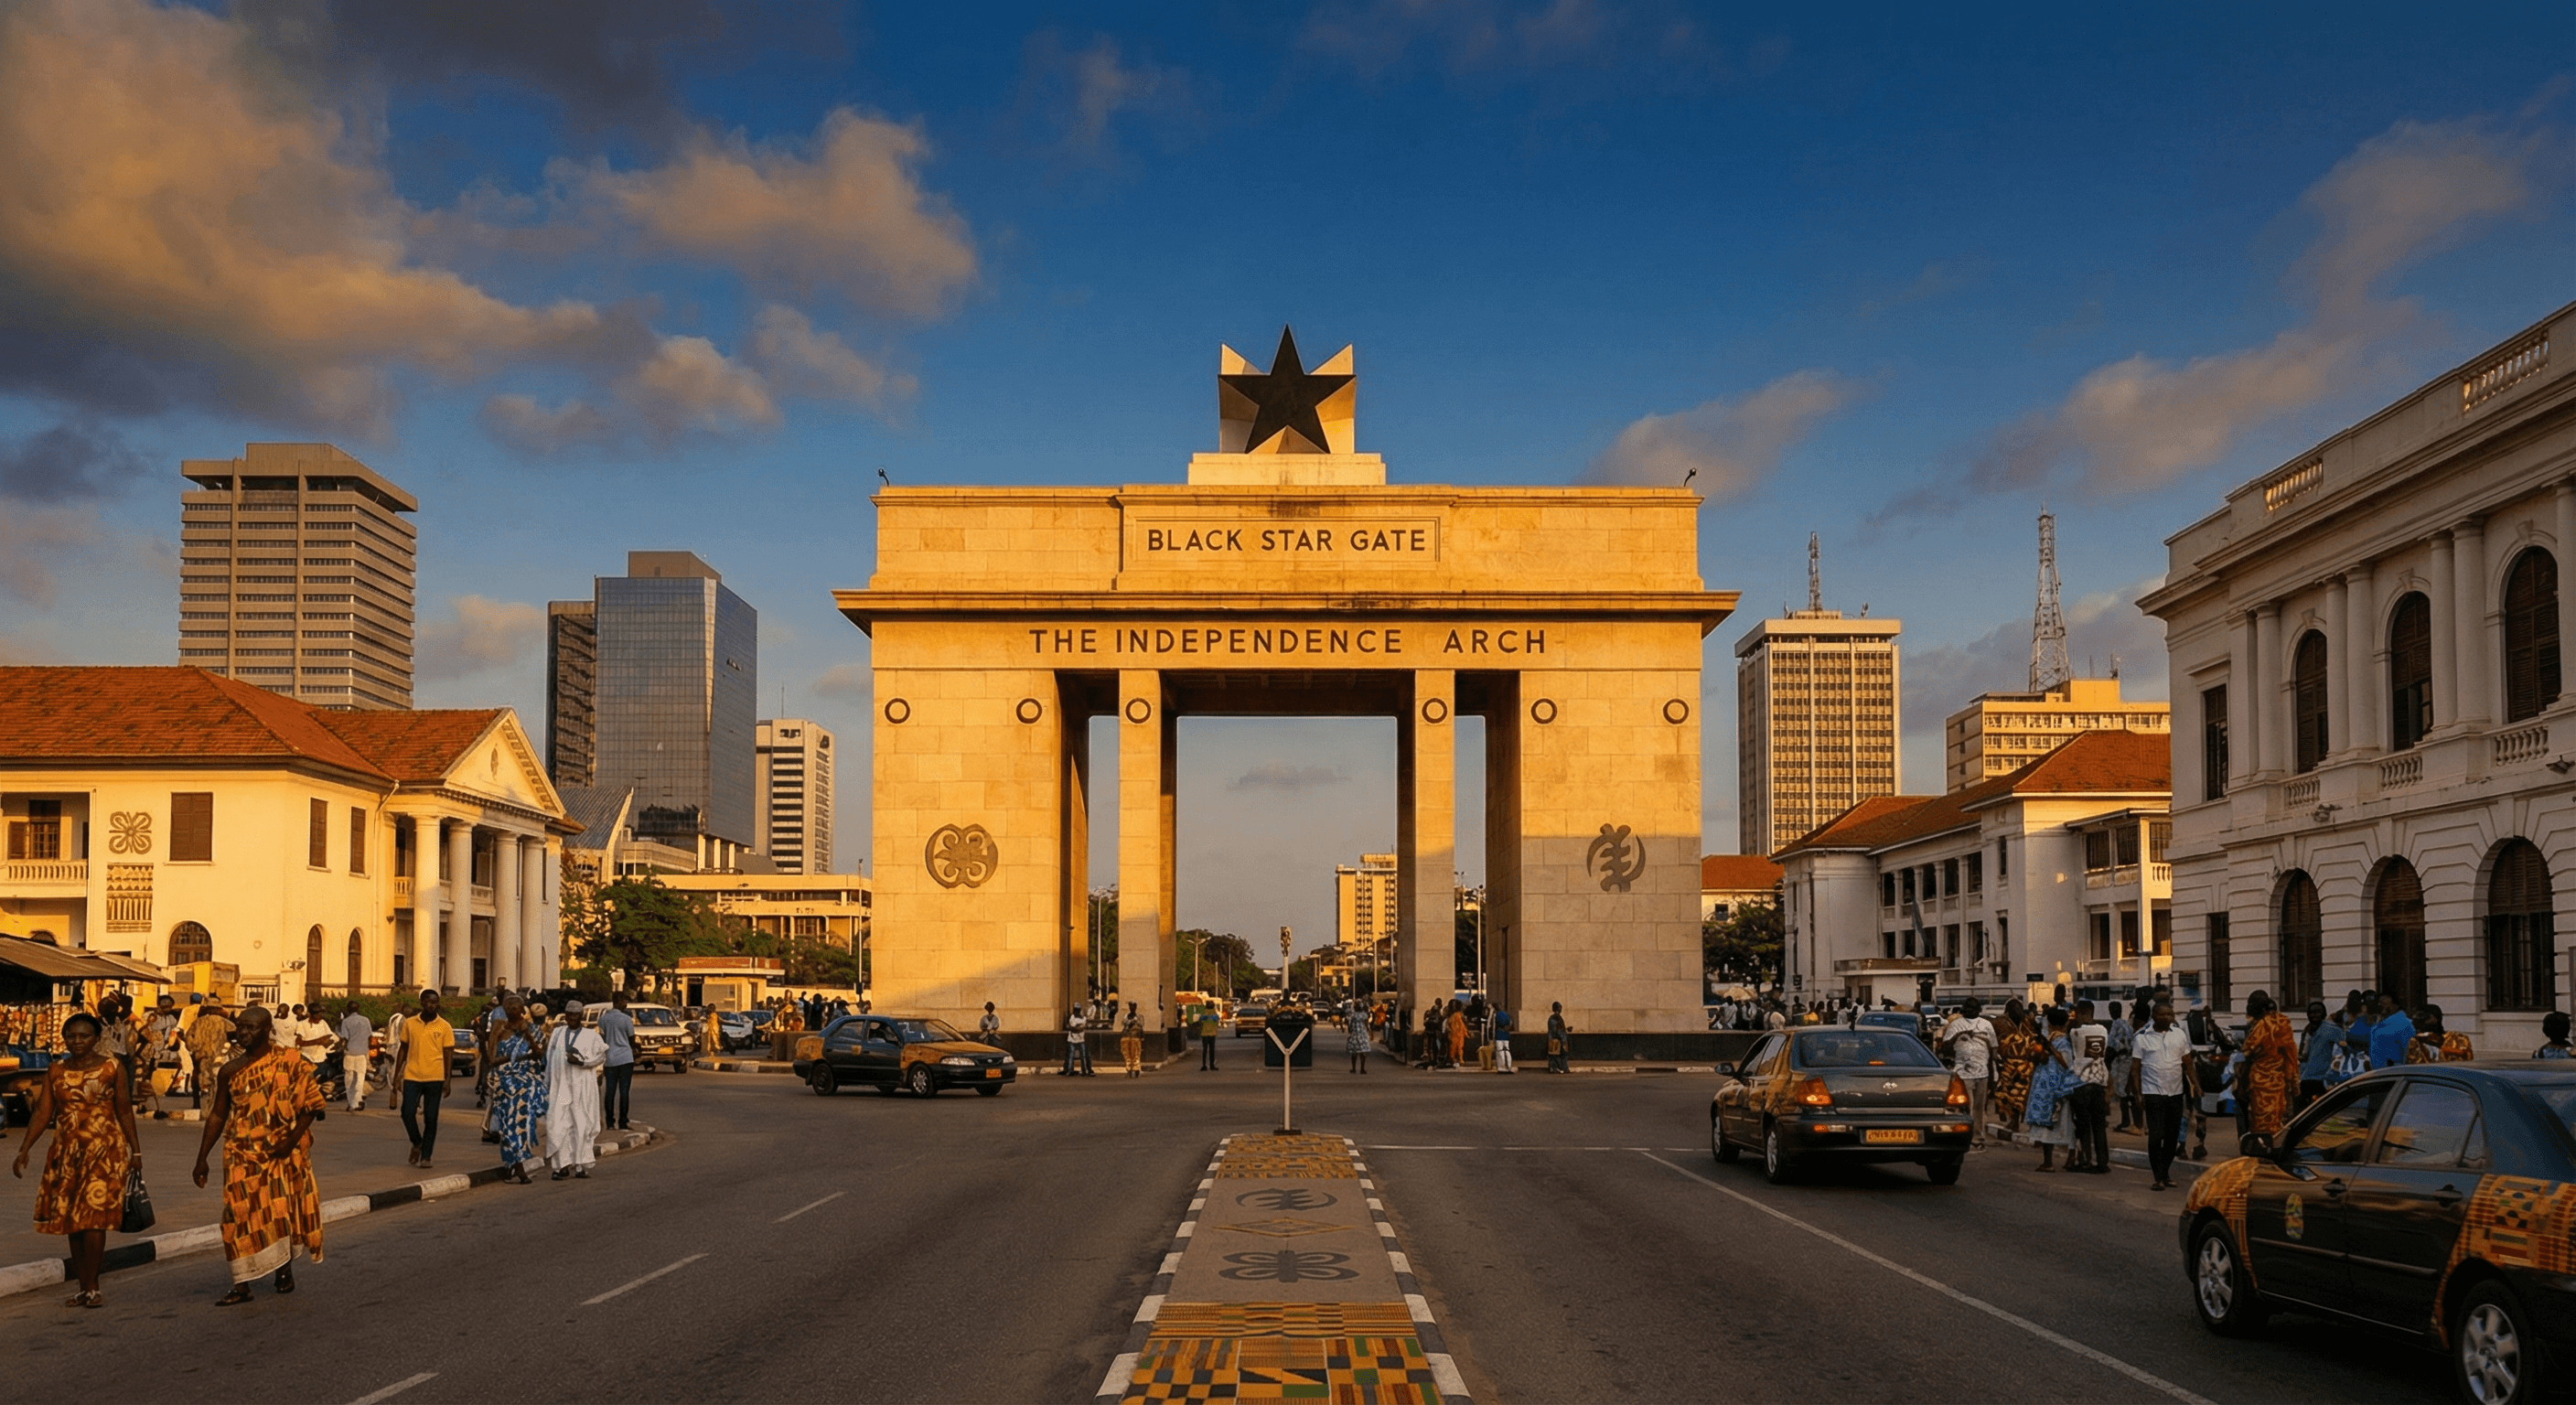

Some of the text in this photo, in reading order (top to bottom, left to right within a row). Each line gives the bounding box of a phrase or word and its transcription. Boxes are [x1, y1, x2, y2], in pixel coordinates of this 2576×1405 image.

[1148, 528, 1425, 552] BLACK STAR GATE
[1028, 628, 1546, 653] THE INDEPENDENCE ARCH
